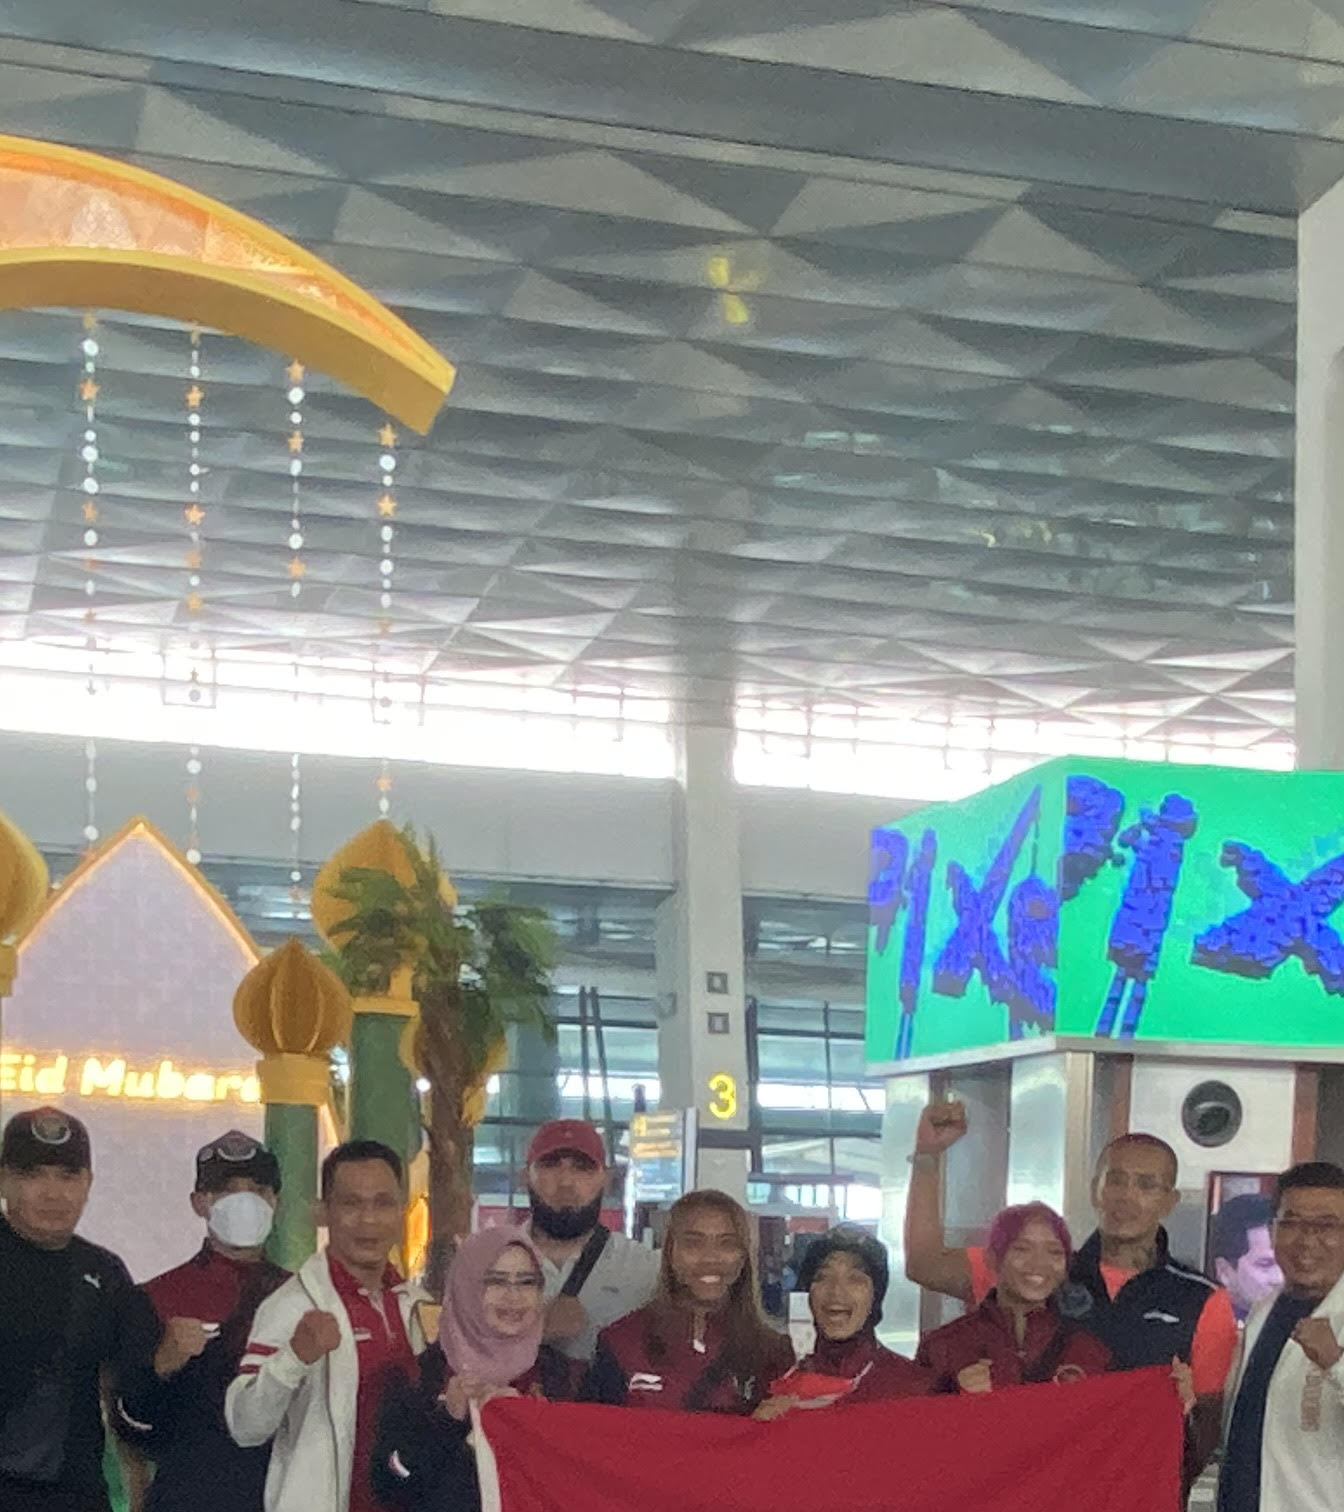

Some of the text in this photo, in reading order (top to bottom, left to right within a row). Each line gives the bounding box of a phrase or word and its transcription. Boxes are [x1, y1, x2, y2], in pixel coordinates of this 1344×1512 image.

[0, 1054, 261, 1103] Eid Mubara
[708, 1073, 737, 1119] 3
